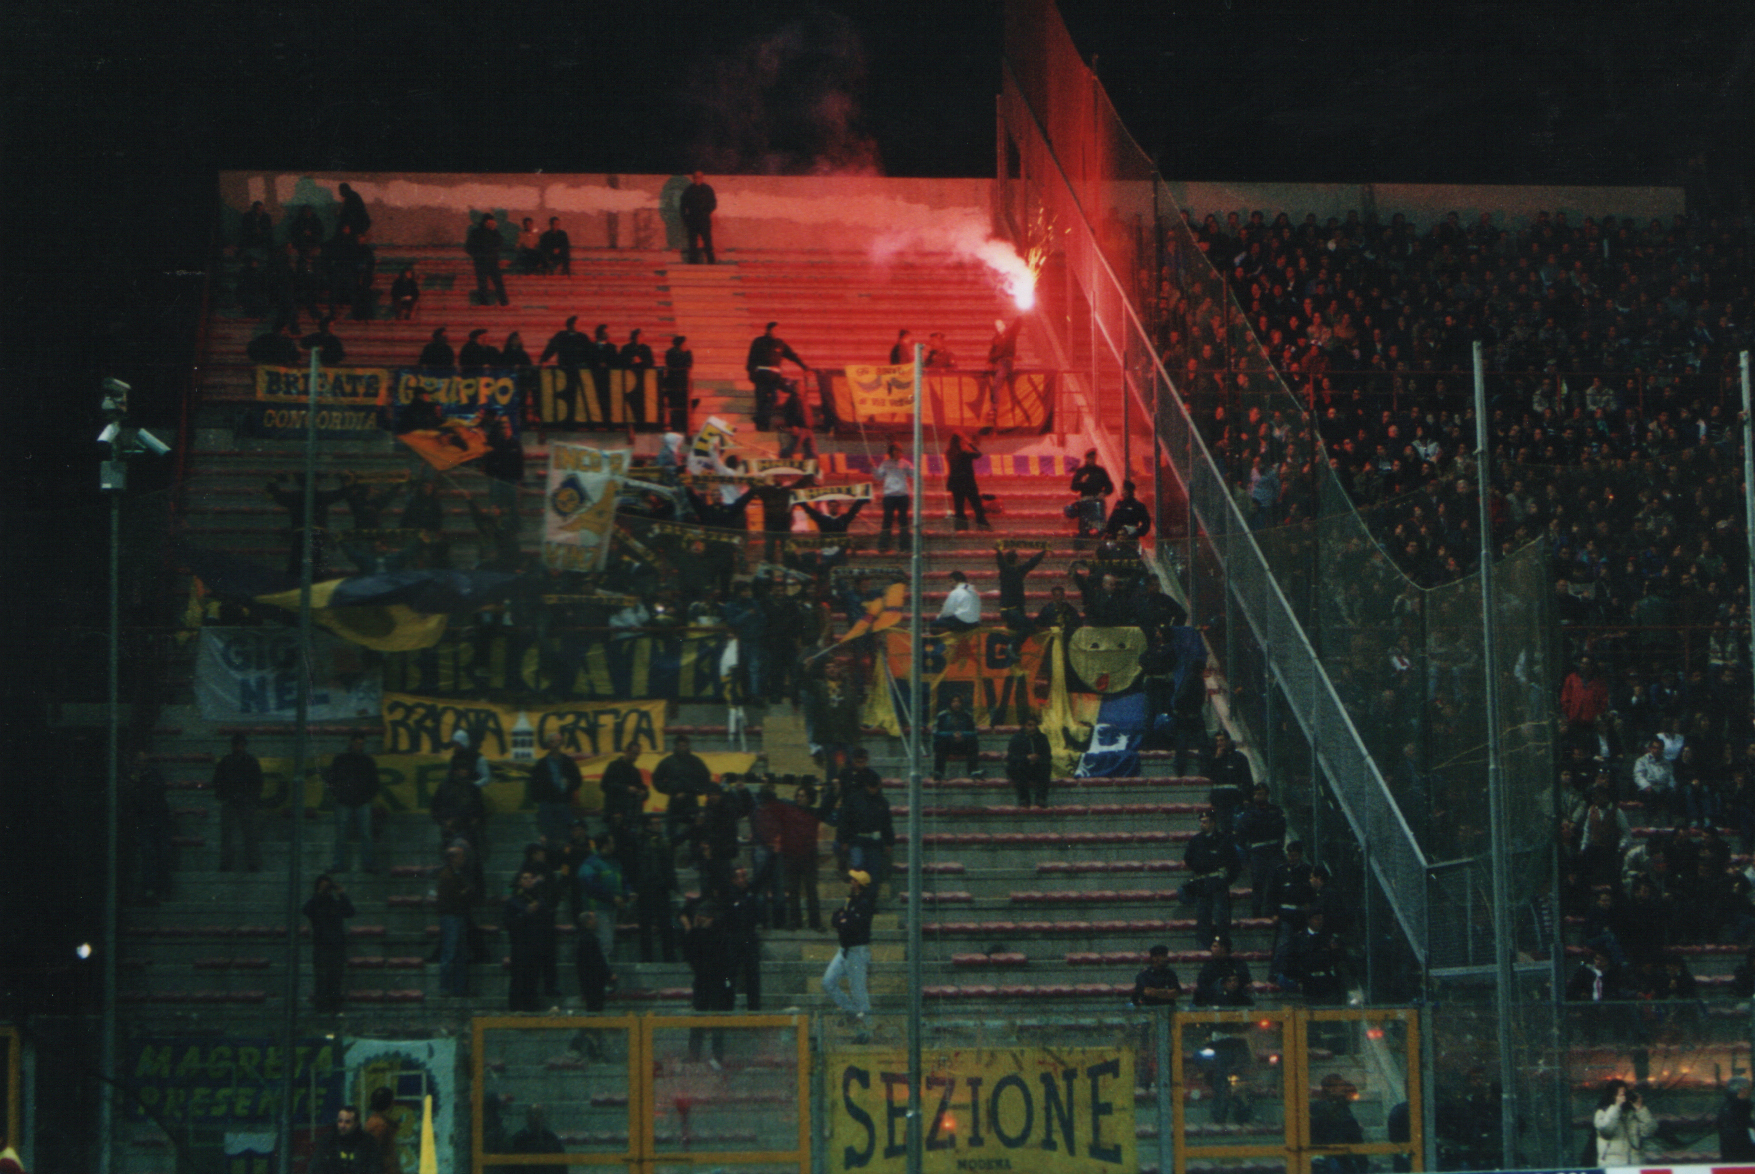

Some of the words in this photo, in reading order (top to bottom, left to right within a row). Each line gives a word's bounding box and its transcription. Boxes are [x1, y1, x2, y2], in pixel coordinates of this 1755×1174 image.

[540, 368, 659, 423] BARI
[134, 1044, 334, 1080] MAGRETA
[842, 1058, 1123, 1170] SEZIONE
